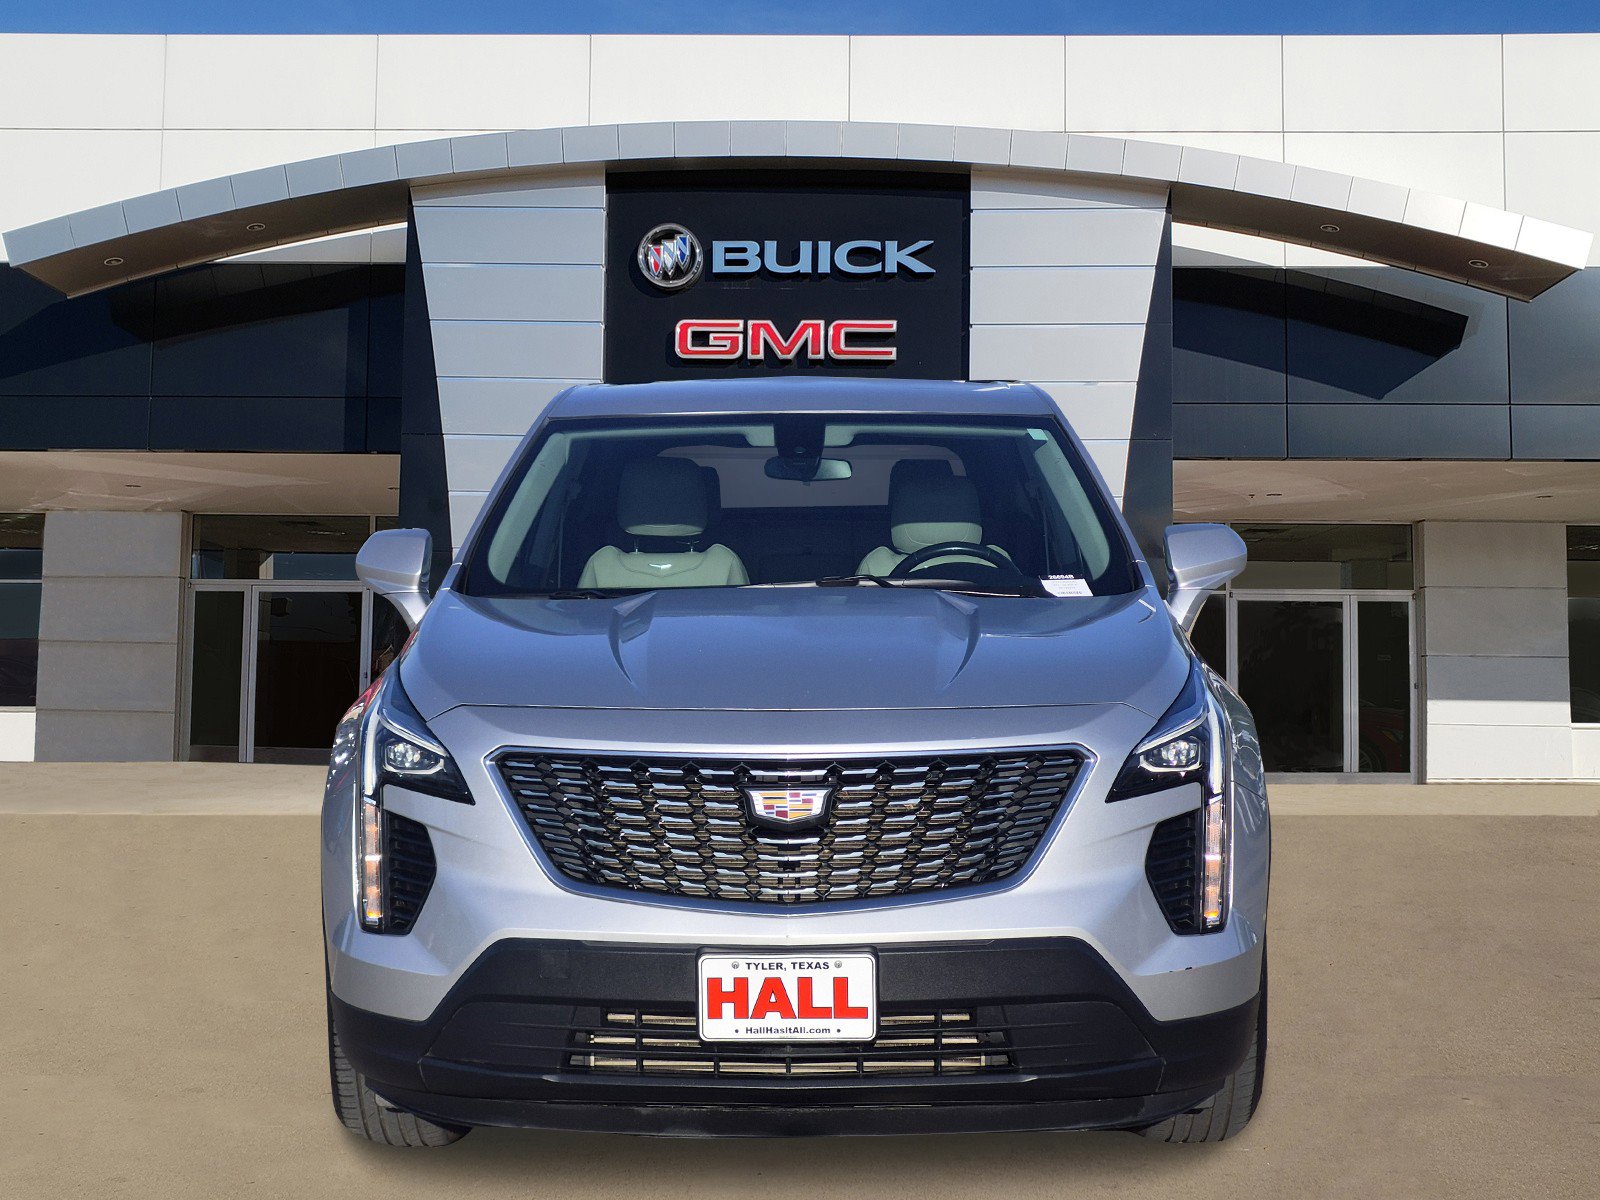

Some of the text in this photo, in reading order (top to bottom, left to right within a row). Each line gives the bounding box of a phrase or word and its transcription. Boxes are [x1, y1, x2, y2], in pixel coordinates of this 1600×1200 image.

[712, 240, 936, 273] BUICK
[675, 319, 898, 360] GMC
[746, 961, 829, 971] TYLER, TEXAS
[707, 977, 868, 1019] HALL
[746, 1026, 831, 1034] HallHasItAll.com
